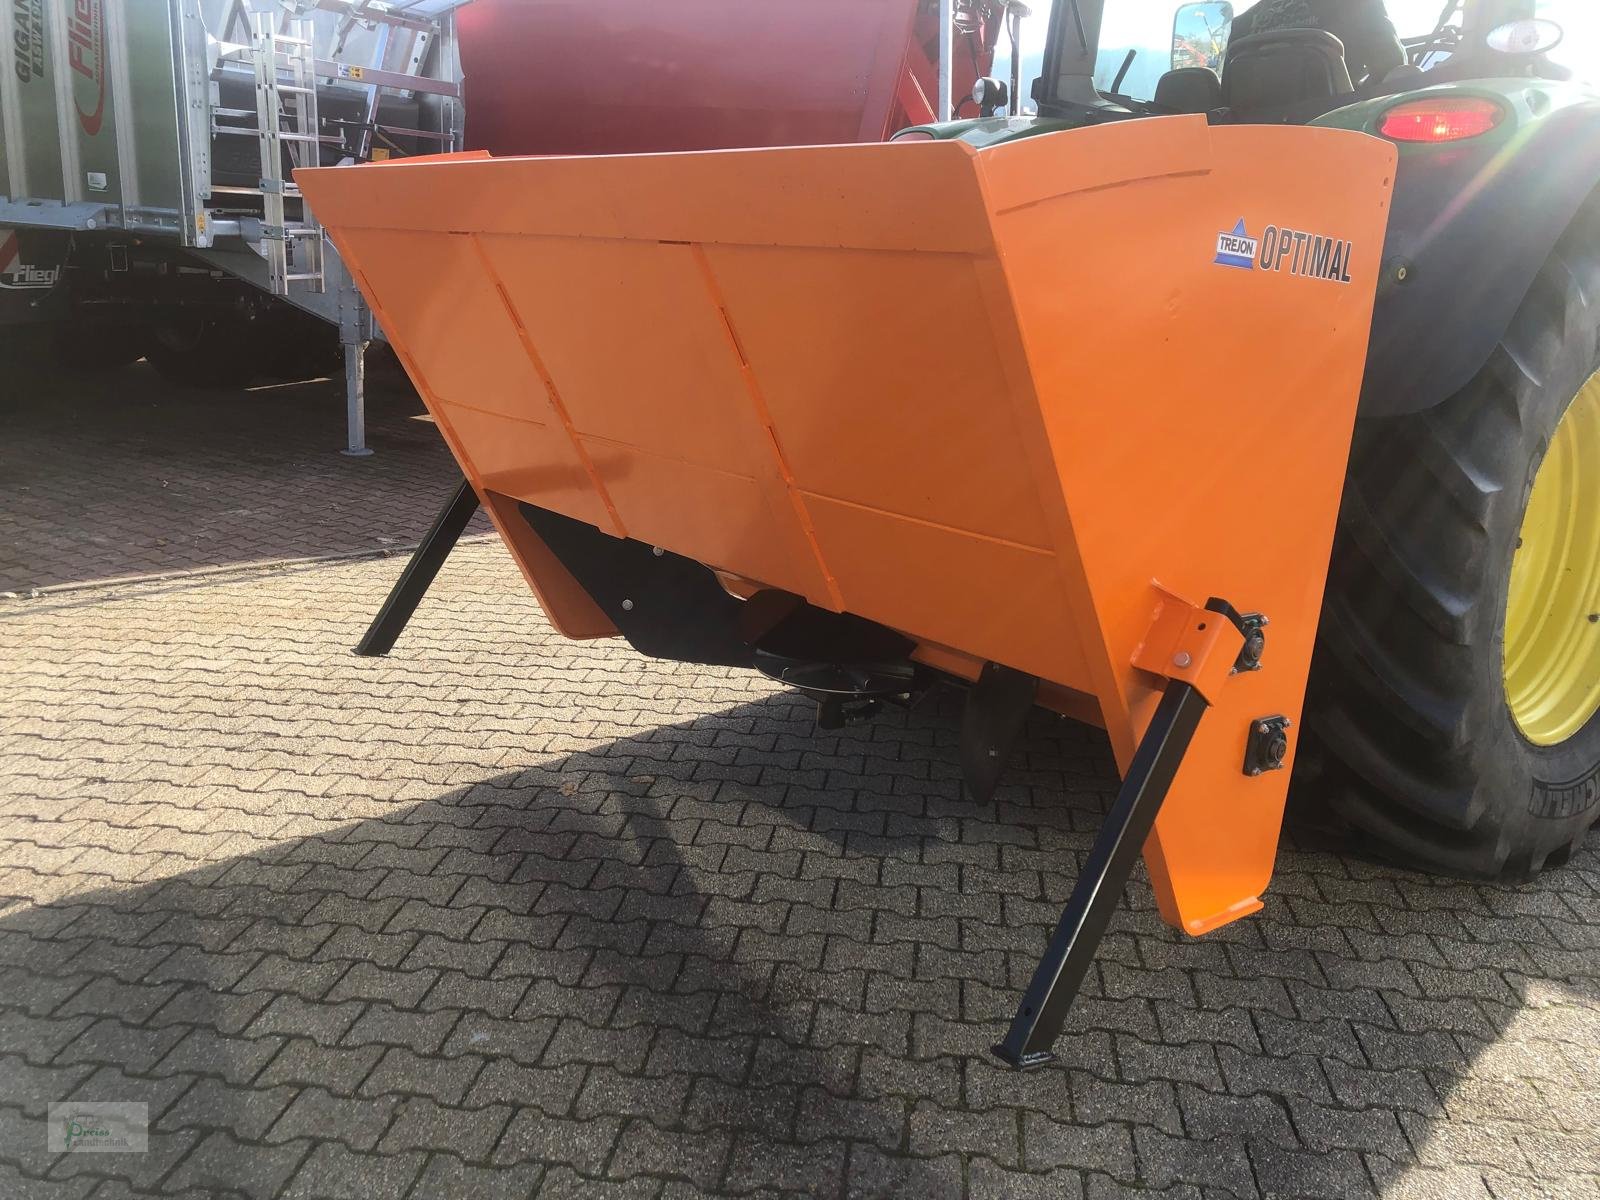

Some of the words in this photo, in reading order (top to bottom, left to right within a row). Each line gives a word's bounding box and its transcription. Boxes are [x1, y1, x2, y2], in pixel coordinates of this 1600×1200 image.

[1219, 236, 1254, 255] TREJON
[1259, 224, 1351, 282] OPTIMAL
[11, 264, 60, 285] Fliegl
